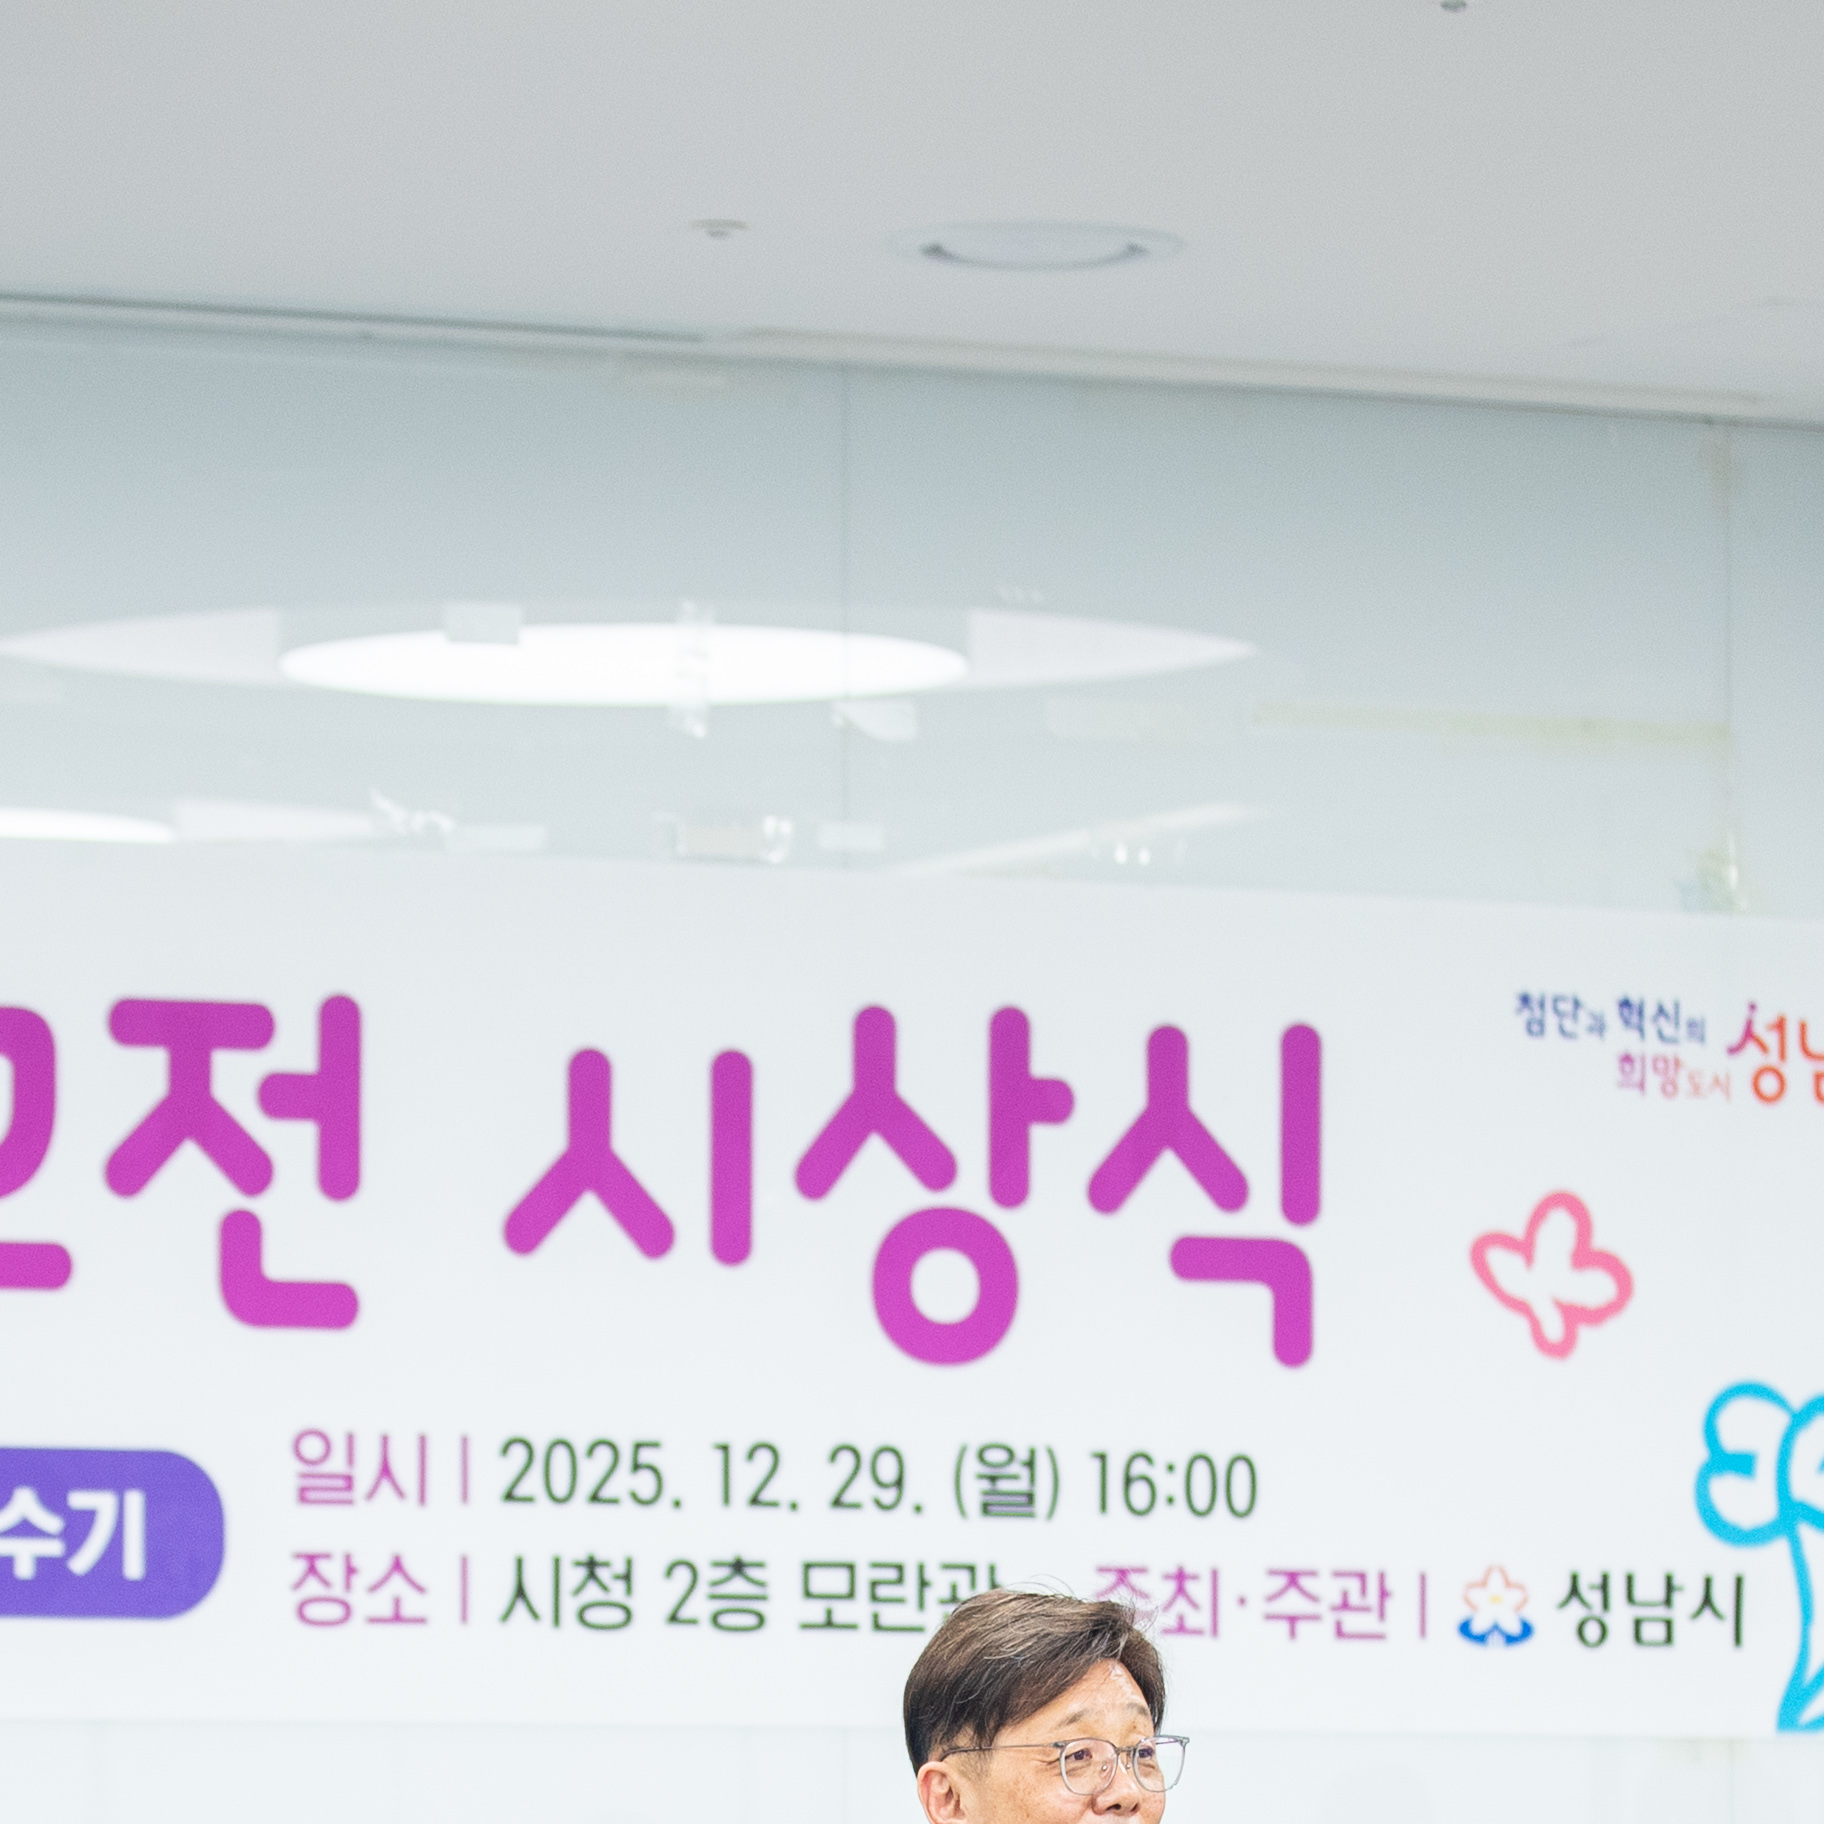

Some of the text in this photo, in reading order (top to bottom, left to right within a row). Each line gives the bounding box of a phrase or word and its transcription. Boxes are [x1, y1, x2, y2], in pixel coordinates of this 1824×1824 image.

[1516, 990, 1607, 1040] 첨단과
[500, 1000, 1325, 1372] 시상식
[292, 1428, 1259, 1520] 일시 2025. 12. 29. (월) 16:00
[292, 1551, 428, 1628] 장소
[499, 1552, 634, 1632] 시청
[664, 1554, 770, 1634] 2층
[1557, 1570, 1746, 1650] 성남시
